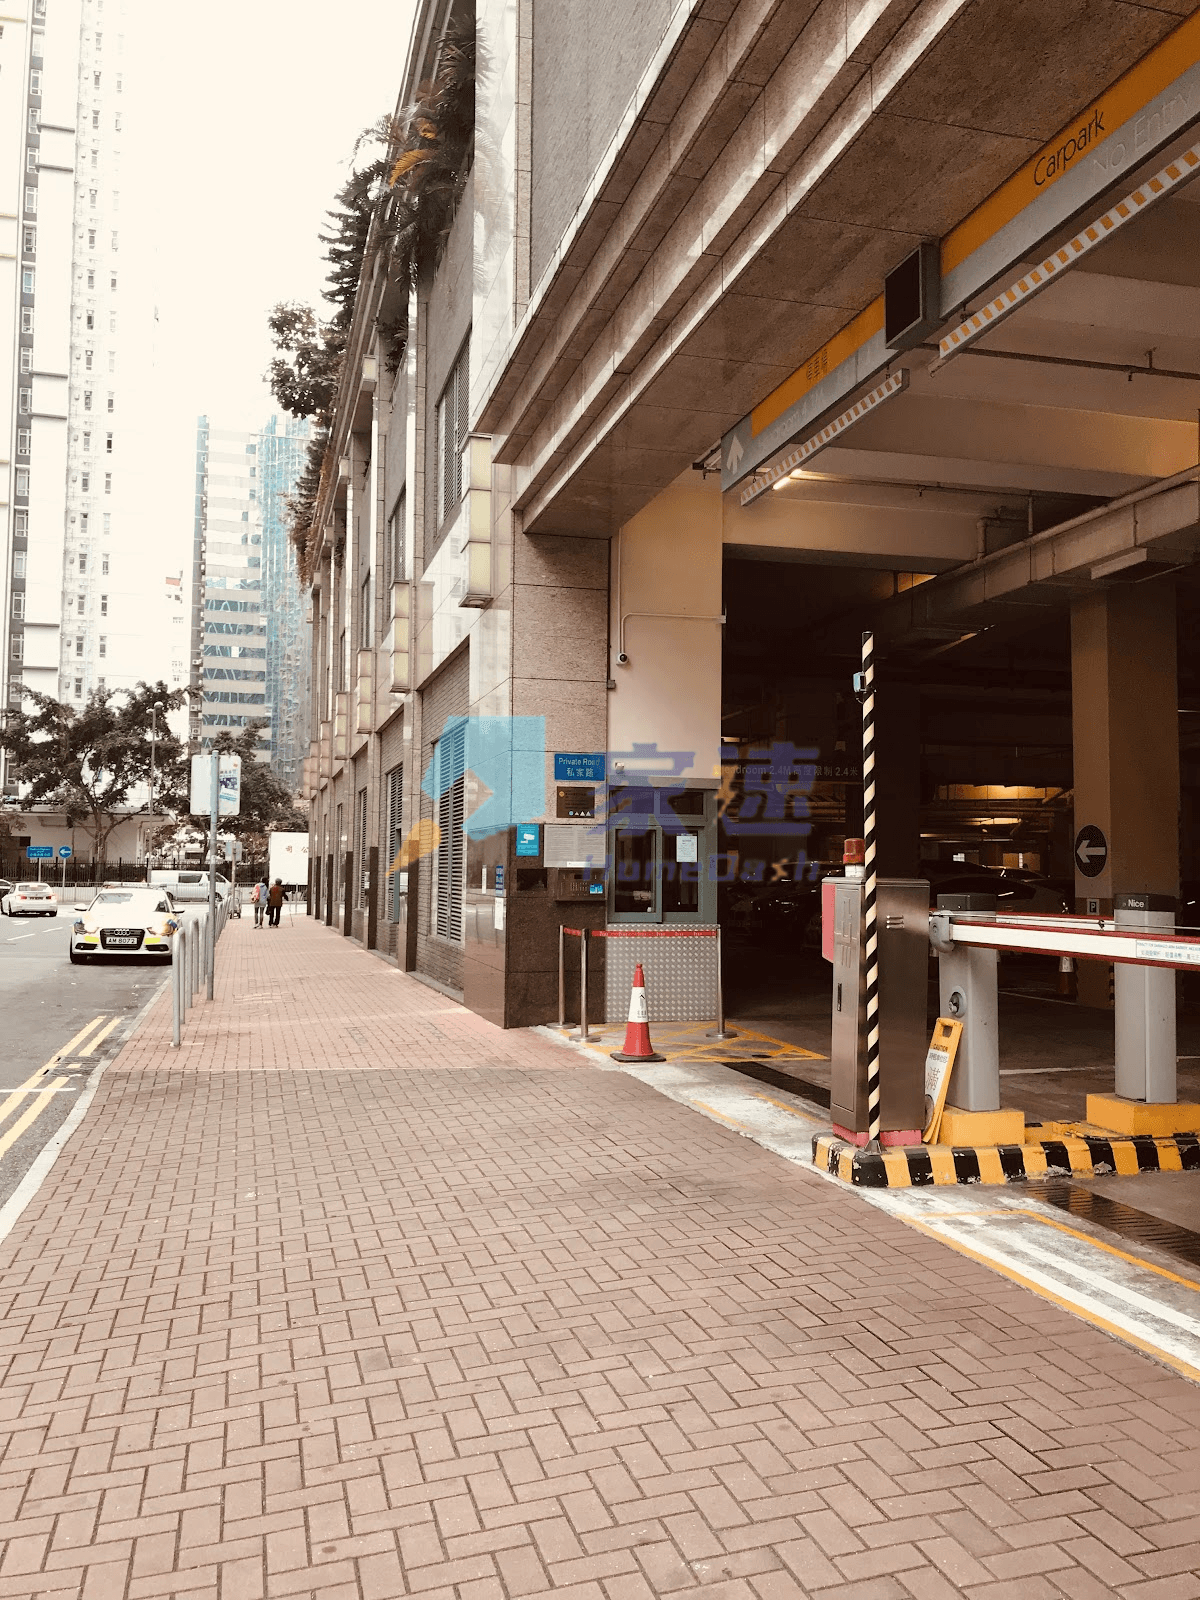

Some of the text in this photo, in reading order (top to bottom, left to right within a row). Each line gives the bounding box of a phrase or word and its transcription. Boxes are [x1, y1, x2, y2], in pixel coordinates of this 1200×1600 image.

[1034, 109, 1105, 187] Carpark
[1092, 143, 1127, 184] No
[558, 757, 582, 766] Private
[566, 767, 594, 778] 私家路
[1128, 899, 1145, 908] Nice
